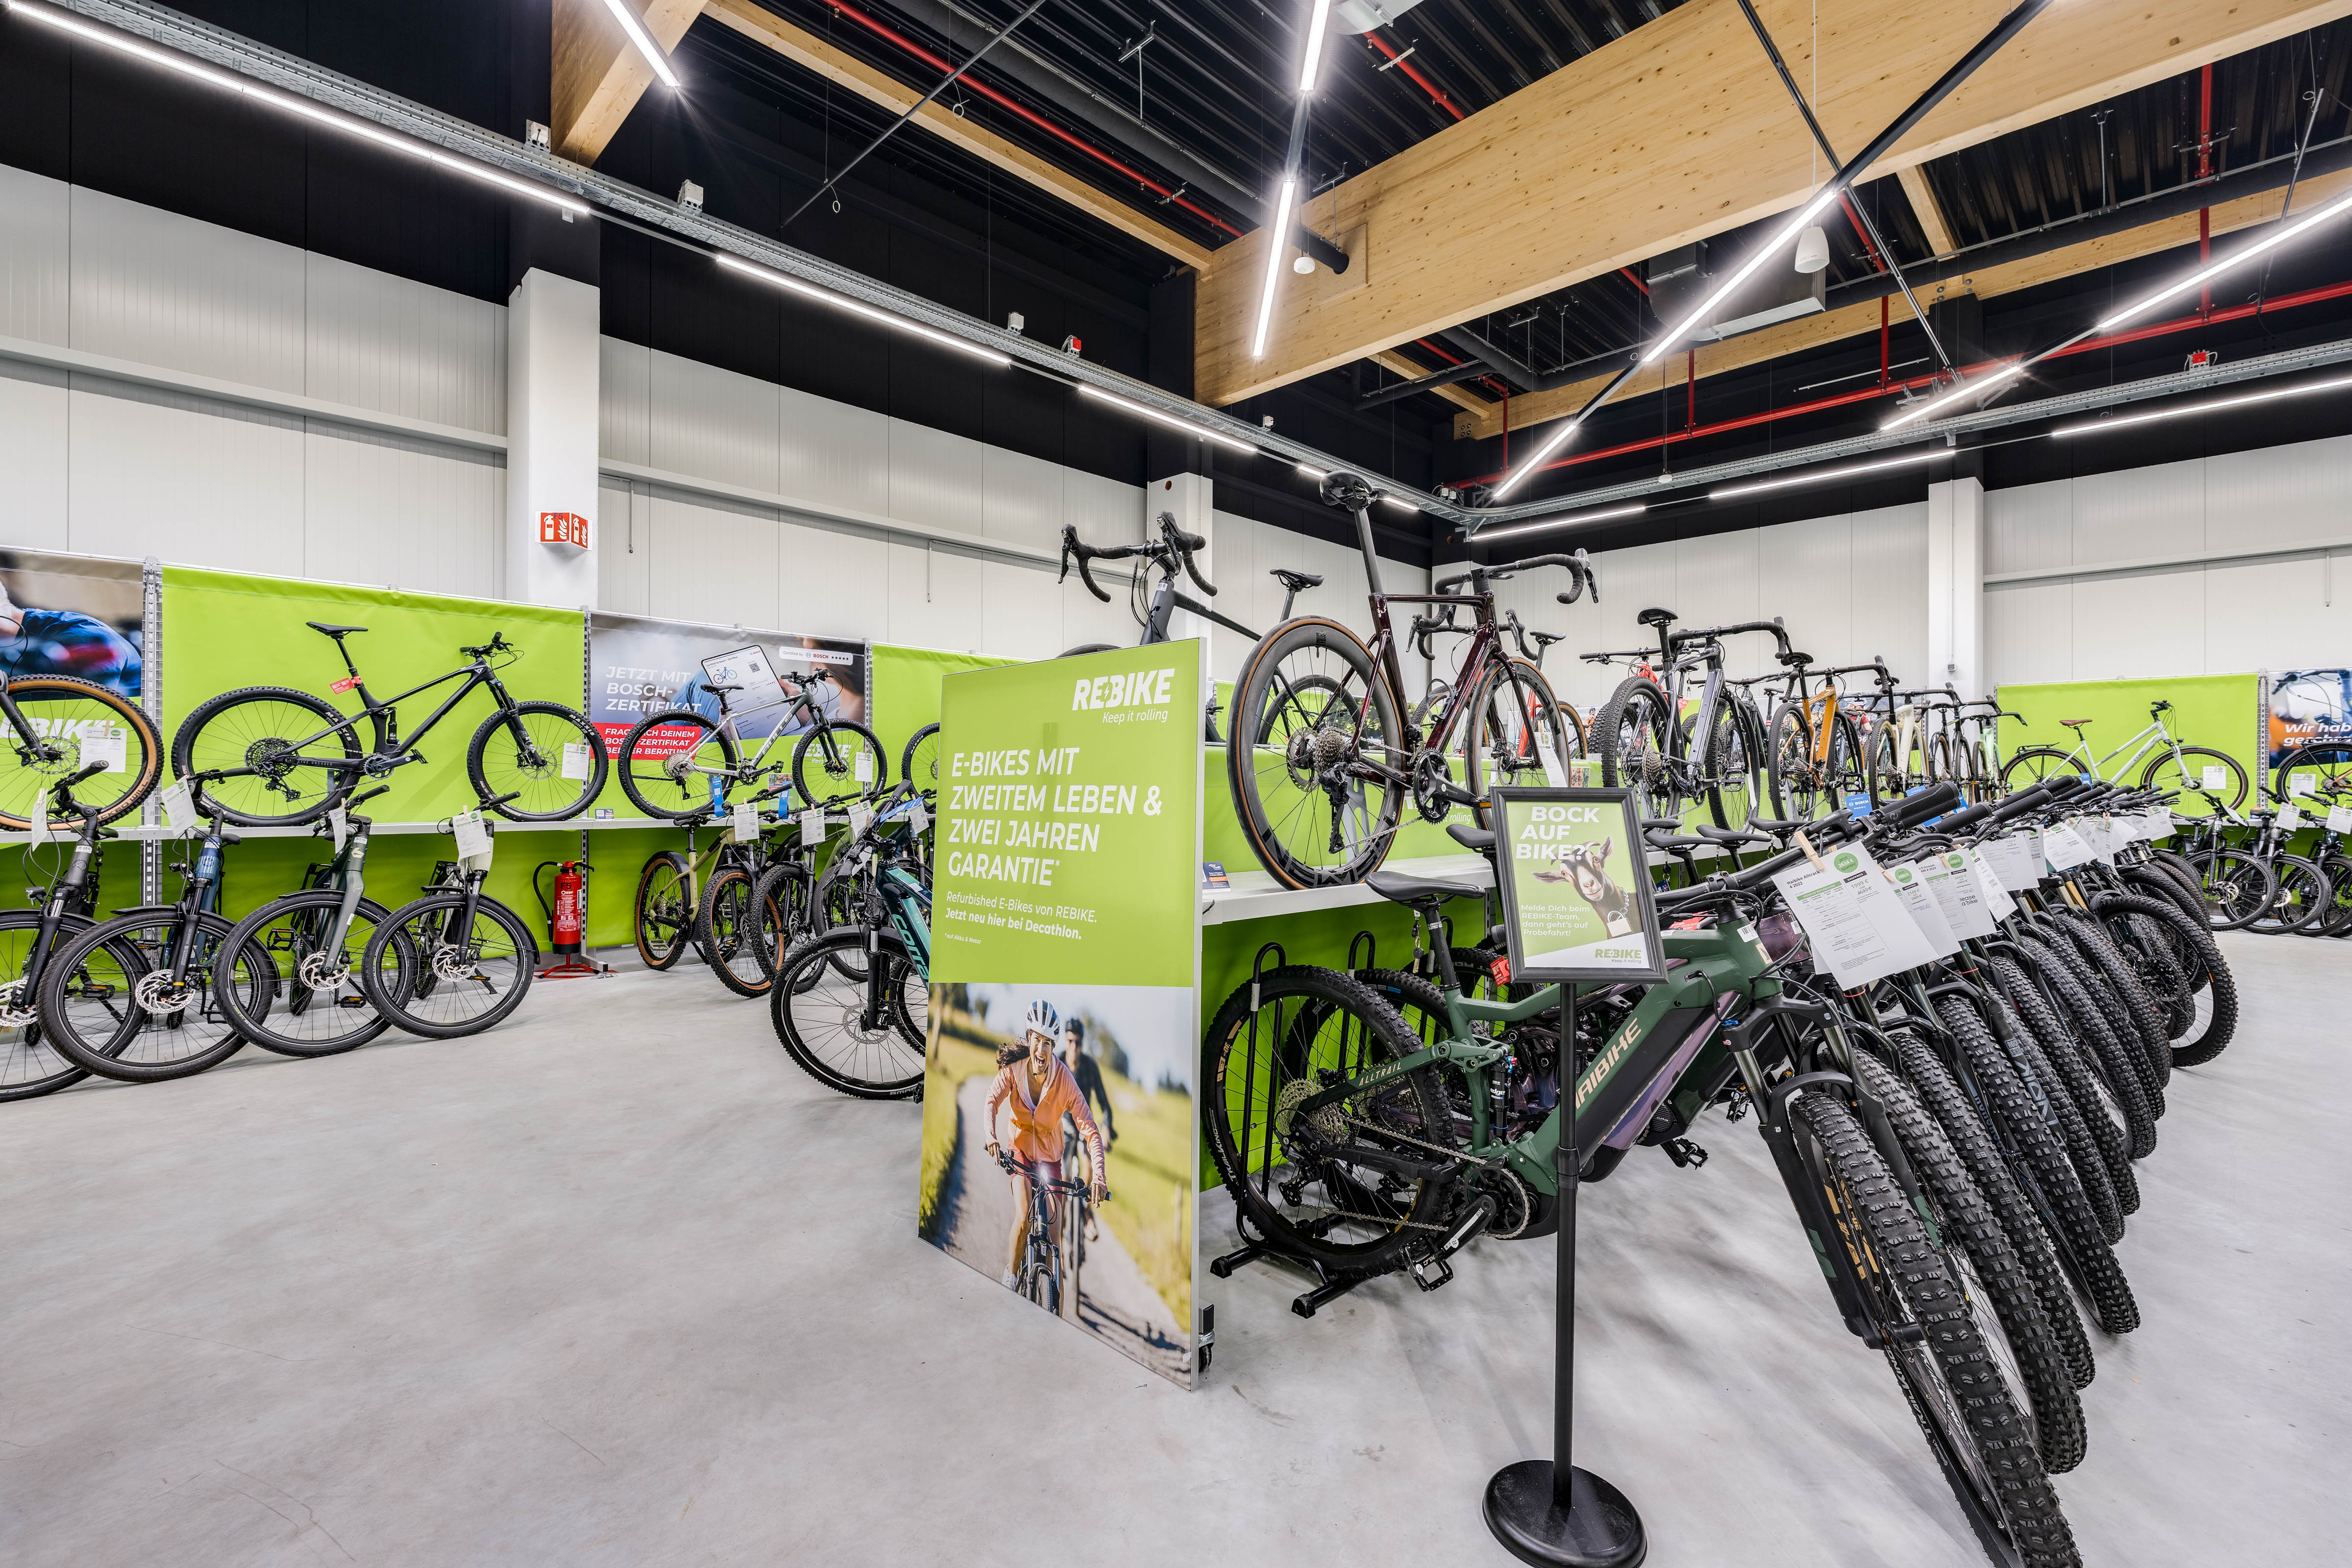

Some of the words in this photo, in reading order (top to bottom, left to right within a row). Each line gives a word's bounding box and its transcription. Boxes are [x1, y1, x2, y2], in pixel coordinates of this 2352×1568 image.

[605, 666, 658, 681] JETZT
[661, 670, 691, 683] MIT
[606, 682, 673, 697] BOSCH-
[1072, 668, 1176, 711] REBIKE
[605, 698, 702, 713] ZERTIFIKAT
[568, 714, 595, 736] MAXXIS
[571, 720, 583, 729] SWISS
[1102, 710, 1126, 725] Keep
[1127, 710, 1134, 723] it
[1136, 709, 1168, 723] rolling
[325, 711, 352, 742] MAXIS
[762, 712, 793, 755] BULLS
[2285, 723, 2316, 734] Wir
[605, 737, 690, 746] BOS-ZERTIFIKAT
[951, 749, 1030, 777] E-BIKES
[1036, 747, 1080, 776] MIT
[129, 781, 148, 802] WILL
[950, 784, 1047, 812] ZWEITEM
[1053, 785, 1137, 814] LEBEN
[1143, 785, 1163, 817] &
[98, 801, 130, 821] CKED
[1449, 812, 1471, 825] rolling
[1531, 806, 1600, 823] BOCK
[1823, 813, 1837, 821] YAMAHA
[948, 818, 1001, 845] ZWEI
[1004, 820, 1101, 852] JAHREN
[1520, 825, 1571, 840] AUF
[1516, 843, 1586, 861] BIKE?
[1841, 862, 1856, 872] sparen!
[1787, 876, 1804, 885] Haibike
[1804, 870, 1820, 879] Alltrack
[1850, 881, 1864, 889] 1999
[946, 891, 998, 908] Refurbished
[999, 898, 1033, 913] E-Bikes
[1035, 904, 1053, 916] von
[1055, 905, 1097, 923] REBIKE.
[945, 907, 967, 921] Jetzt
[968, 912, 985, 924] neu
[987, 913, 1006, 927] hier
[1007, 917, 1023, 930] bei
[1025, 919, 1082, 940] Decathlon.
[1522, 913, 1580, 921] REBIKE-Team,
[891, 913, 931, 993] corra
[1594, 949, 1642, 959] REBIKE
[784, 946, 832, 981] SCHWALBE
[1358, 1062, 1401, 1086] ALLTRAIL
[889, 1086, 917, 1096] SMAR
[1490, 1088, 1506, 1096] edge
